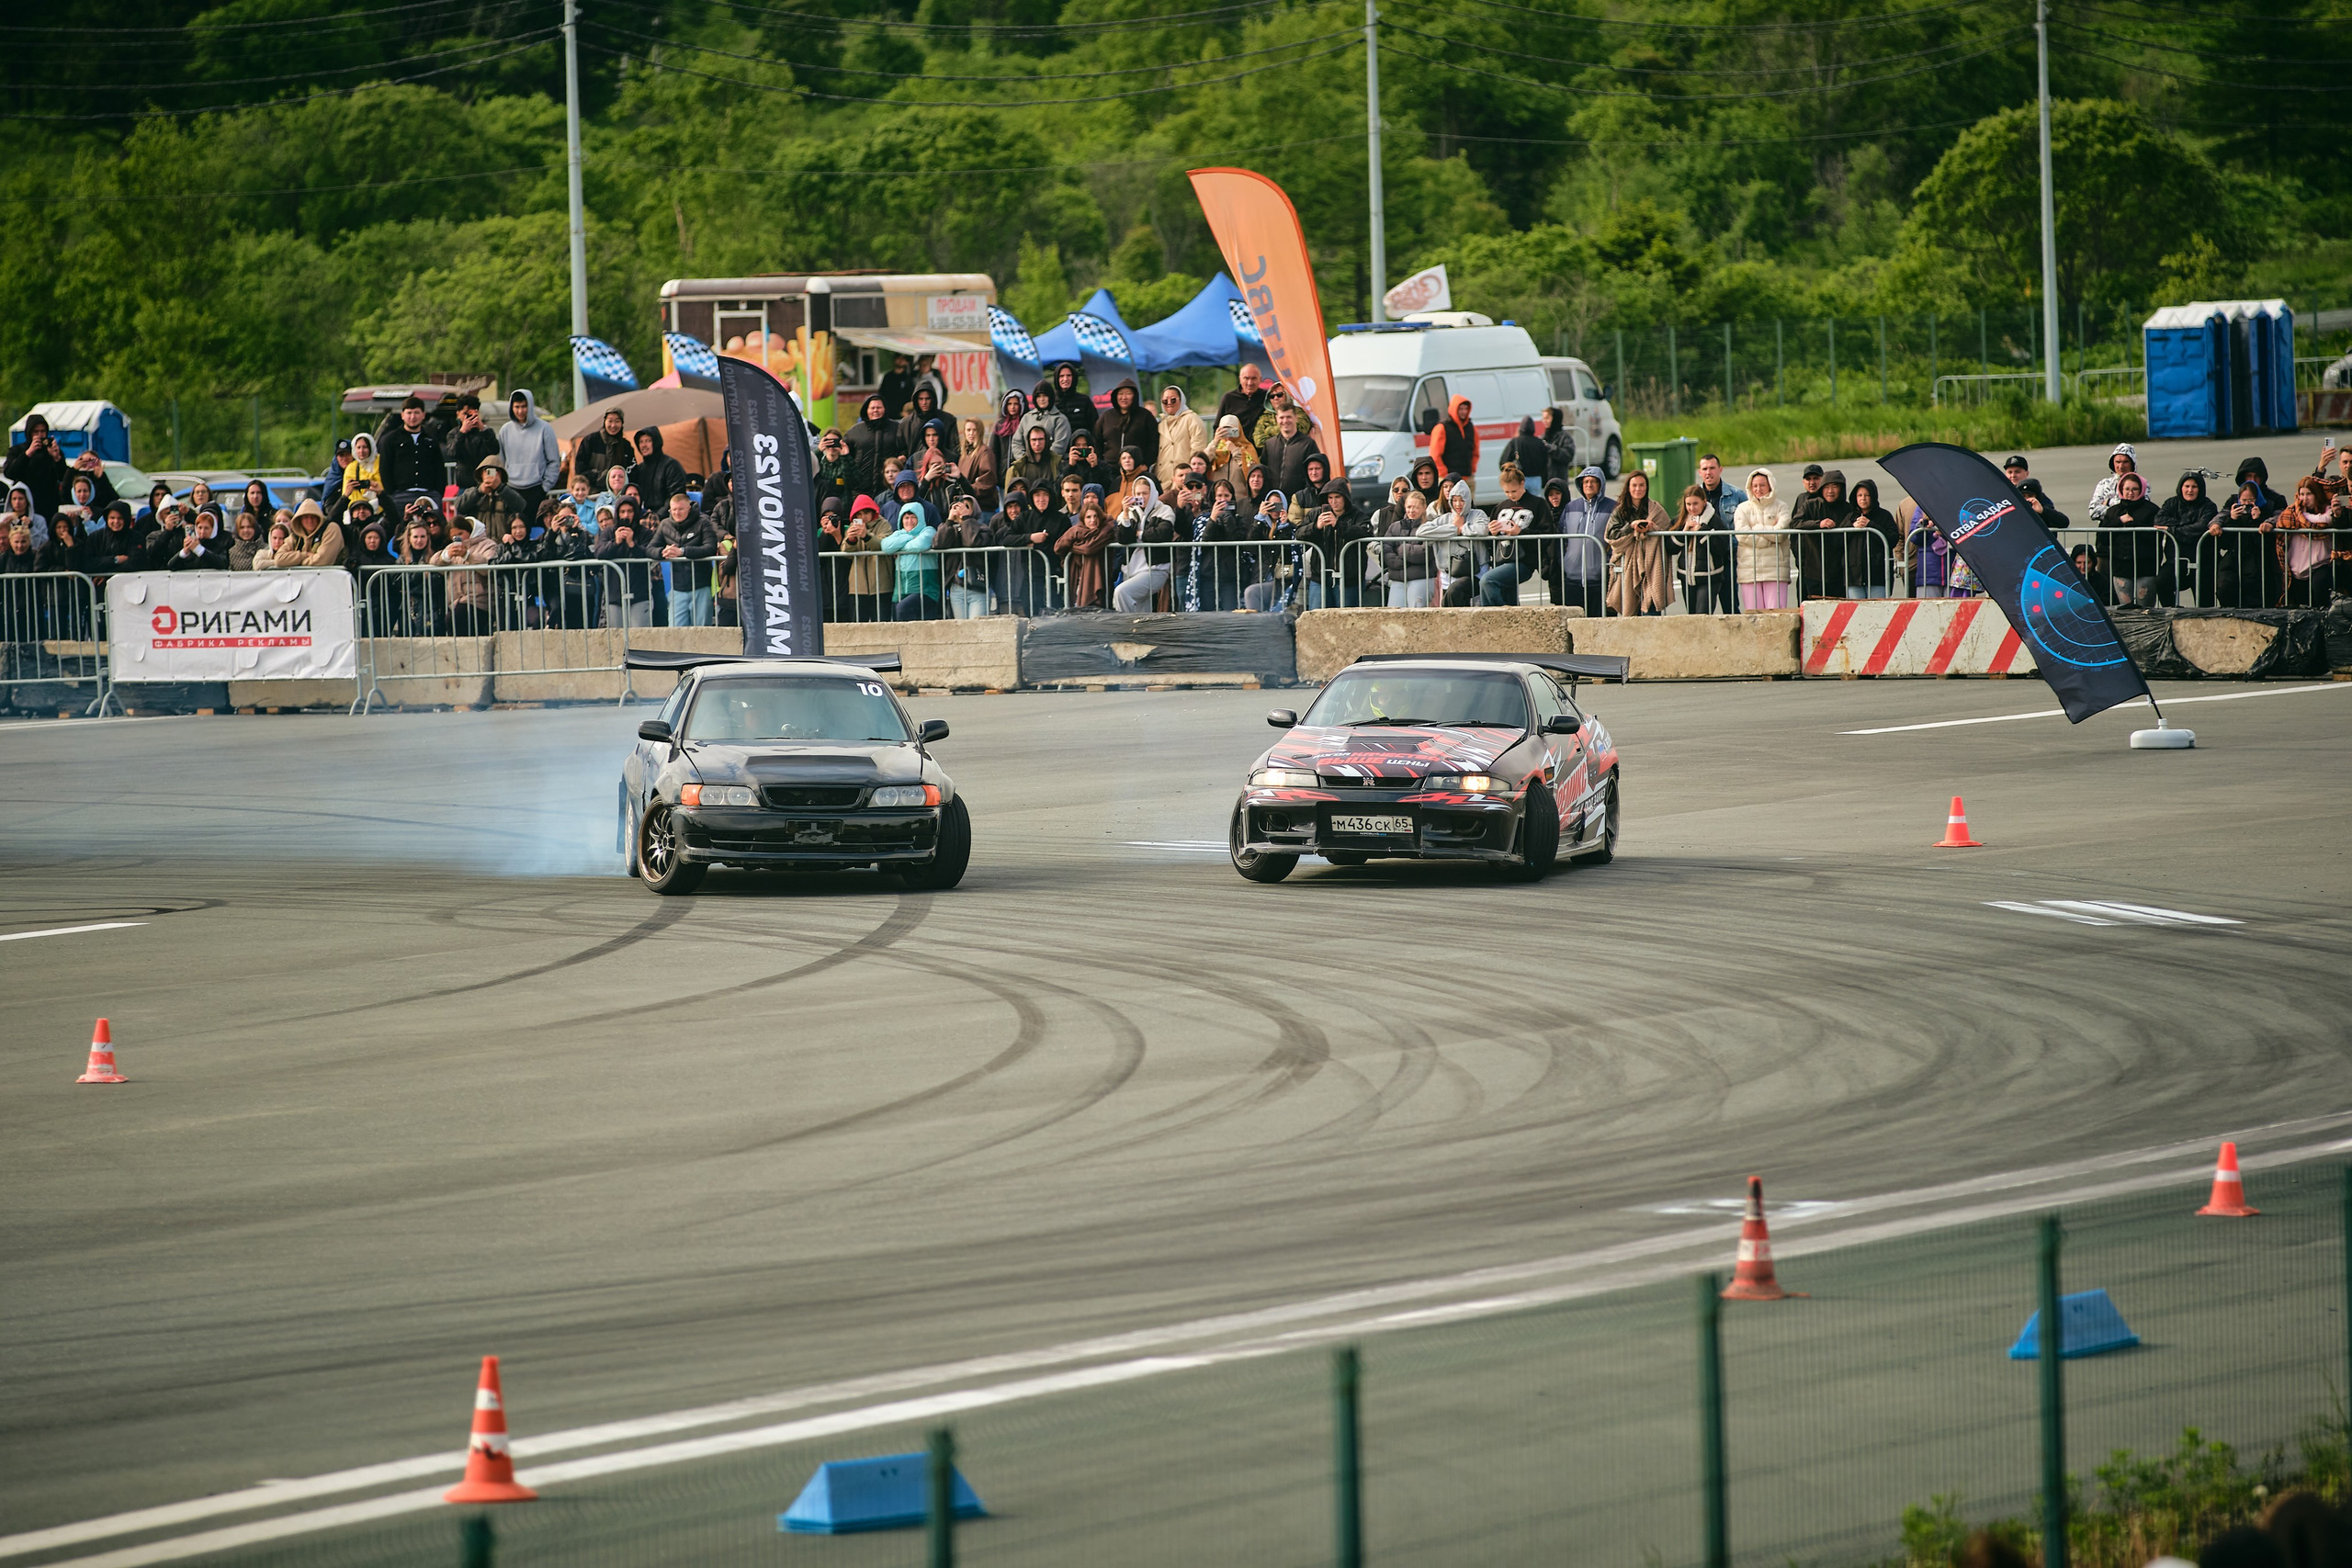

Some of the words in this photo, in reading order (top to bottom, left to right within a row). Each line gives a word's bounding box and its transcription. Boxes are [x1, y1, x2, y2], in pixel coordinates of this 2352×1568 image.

[154, 639, 226, 648] ФАБРИКА
[237, 637, 310, 646] РЕКЛАМЫ
[856, 682, 883, 697] 10
[1317, 756, 1387, 766] ВЫШЕ
[1385, 759, 1430, 768] ЦЕНЫ
[1395, 818, 1408, 828] 65
